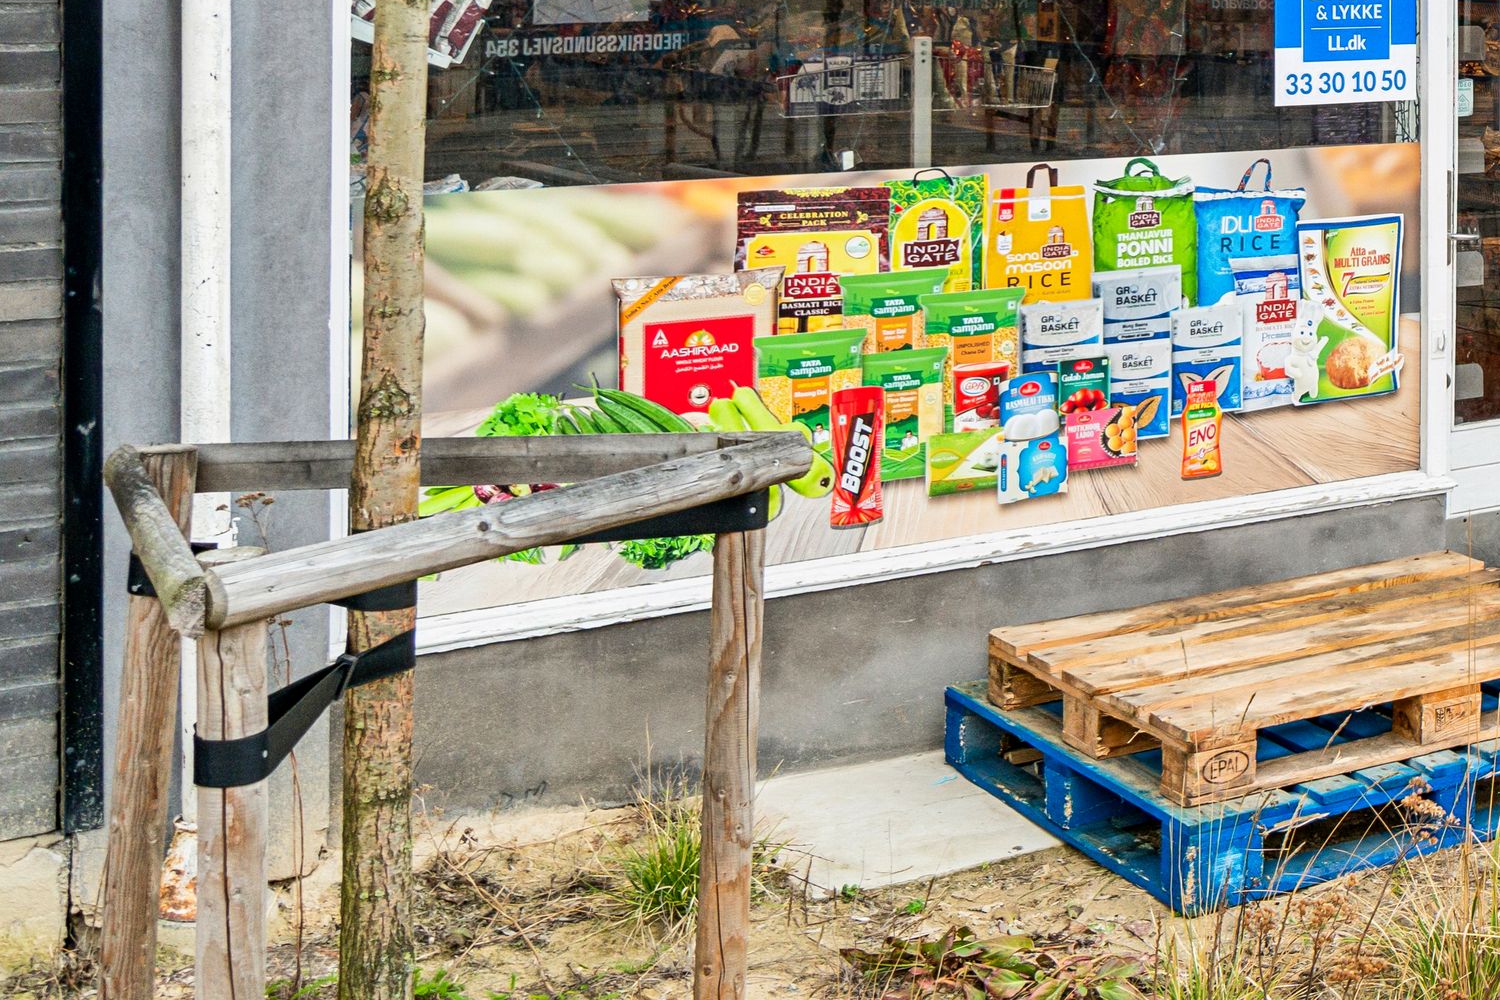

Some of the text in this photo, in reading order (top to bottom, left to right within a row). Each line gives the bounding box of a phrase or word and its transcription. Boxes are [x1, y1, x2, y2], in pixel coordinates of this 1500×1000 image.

[1316, 3, 1383, 20] & LYKKE
[1328, 35, 1367, 51] LL.dk
[1286, 69, 1407, 95] 33 30 10 50
[780, 210, 849, 220] CELEBRATION
[1131, 219, 1158, 227] GATE
[1220, 215, 1282, 234] IDLI INDIA
[1256, 222, 1281, 230] GATE
[1116, 229, 1173, 241] THANJAVUR
[906, 242, 959, 253] INDIA
[1116, 238, 1173, 258] PONNI
[1220, 234, 1281, 253] RICE
[1350, 247, 1366, 256] Atta
[907, 252, 956, 263] GATE
[1006, 252, 1040, 263] sona
[1116, 254, 1173, 268] BOILED RICE
[1333, 254, 1391, 269] MULTI GRAINS
[787, 277, 838, 287] INDIA
[1007, 271, 1072, 289] RICE
[1341, 271, 1355, 298] 7
[788, 285, 837, 296] GATE
[884, 298, 905, 307] TATA
[1115, 293, 1158, 306] BASKET
[781, 301, 820, 310] BASMATI
[873, 305, 915, 316] sampann
[1258, 303, 1294, 313] INDIA
[794, 308, 830, 316] CLASSIC
[1259, 310, 1294, 320] GATE
[962, 316, 984, 325] TATA
[951, 323, 995, 335] sampann
[1040, 321, 1080, 333] BASKET
[1189, 325, 1224, 336] BASKET
[660, 343, 740, 359] AASHIRVAAD
[956, 341, 991, 350] UNPOLISHED
[800, 359, 822, 367] TATA
[1122, 358, 1153, 369] BASKET
[790, 365, 832, 377] sampann
[892, 374, 912, 382] TATA
[883, 379, 921, 389] sampann
[1188, 423, 1217, 448] ENO
[840, 416, 873, 495] BOOST
[1210, 756, 1243, 780] EPAL
